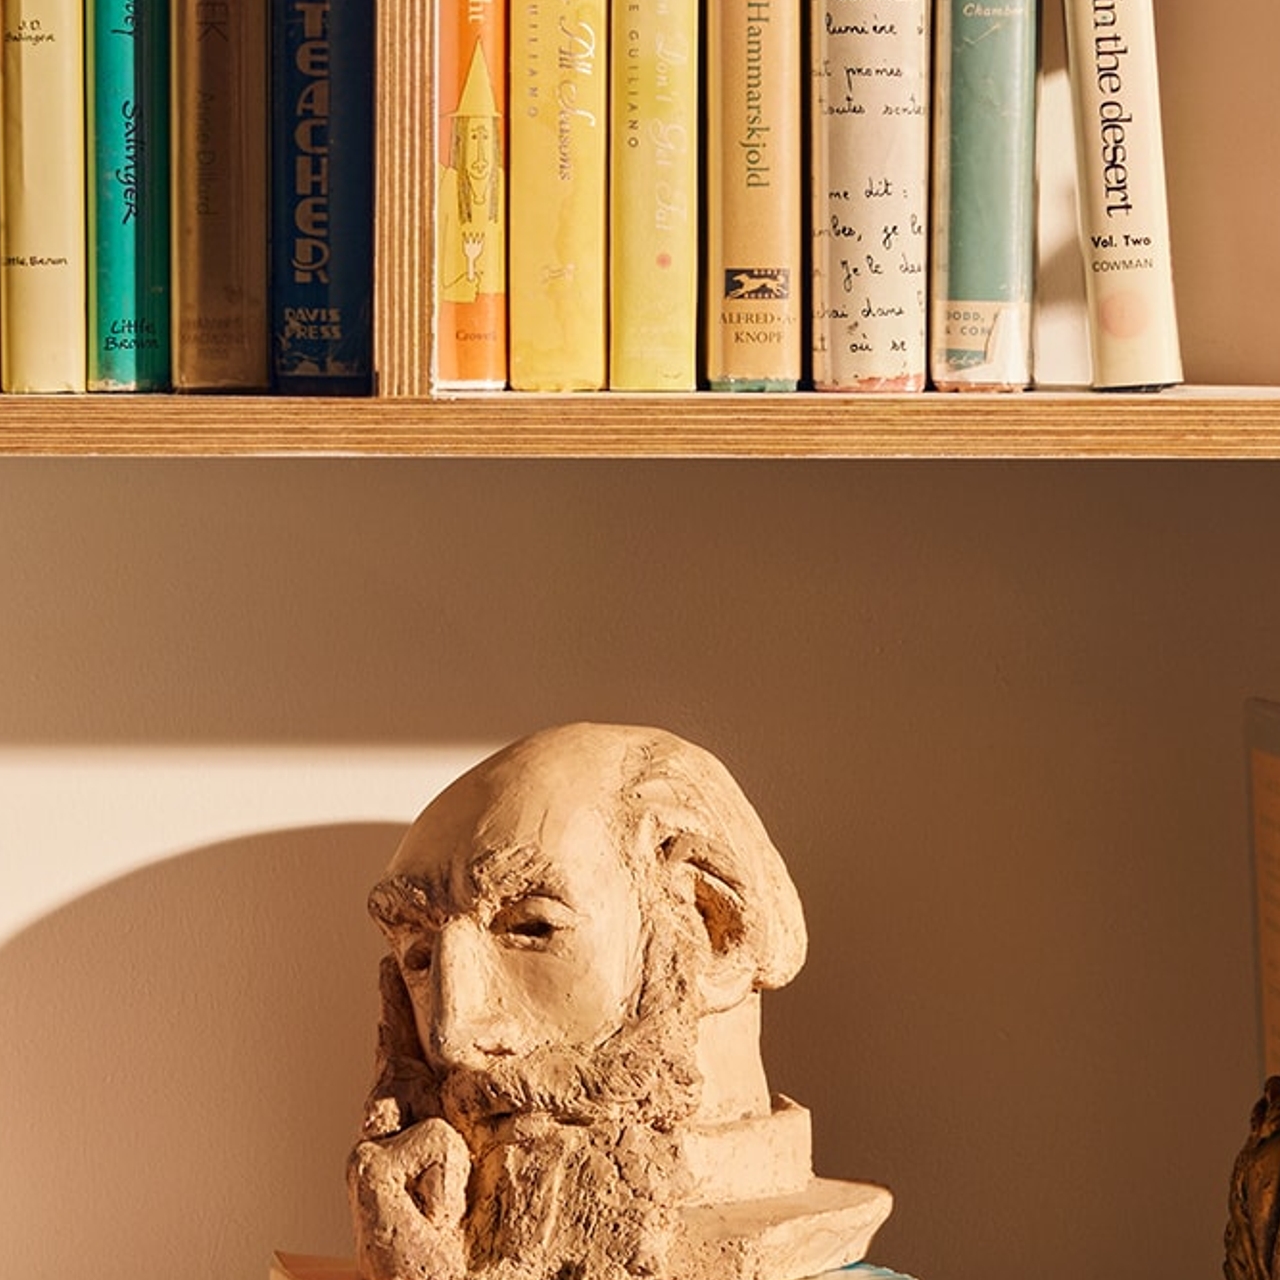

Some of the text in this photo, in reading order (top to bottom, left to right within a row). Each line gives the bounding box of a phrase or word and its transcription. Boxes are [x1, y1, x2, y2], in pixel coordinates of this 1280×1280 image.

[1094, 35, 1129, 95] the
[627, 30, 640, 150] GUILIANO
[291, 2, 332, 285] TEACHER
[1098, 101, 1134, 219] desert
[1091, 236, 1152, 249] Vol. Two
[1092, 258, 1154, 273] COWMAN
[285, 307, 342, 321] DAVIS
[720, 311, 774, 326] ALFRED
[285, 326, 342, 340] PRESS
[734, 331, 784, 345] KNOPF
